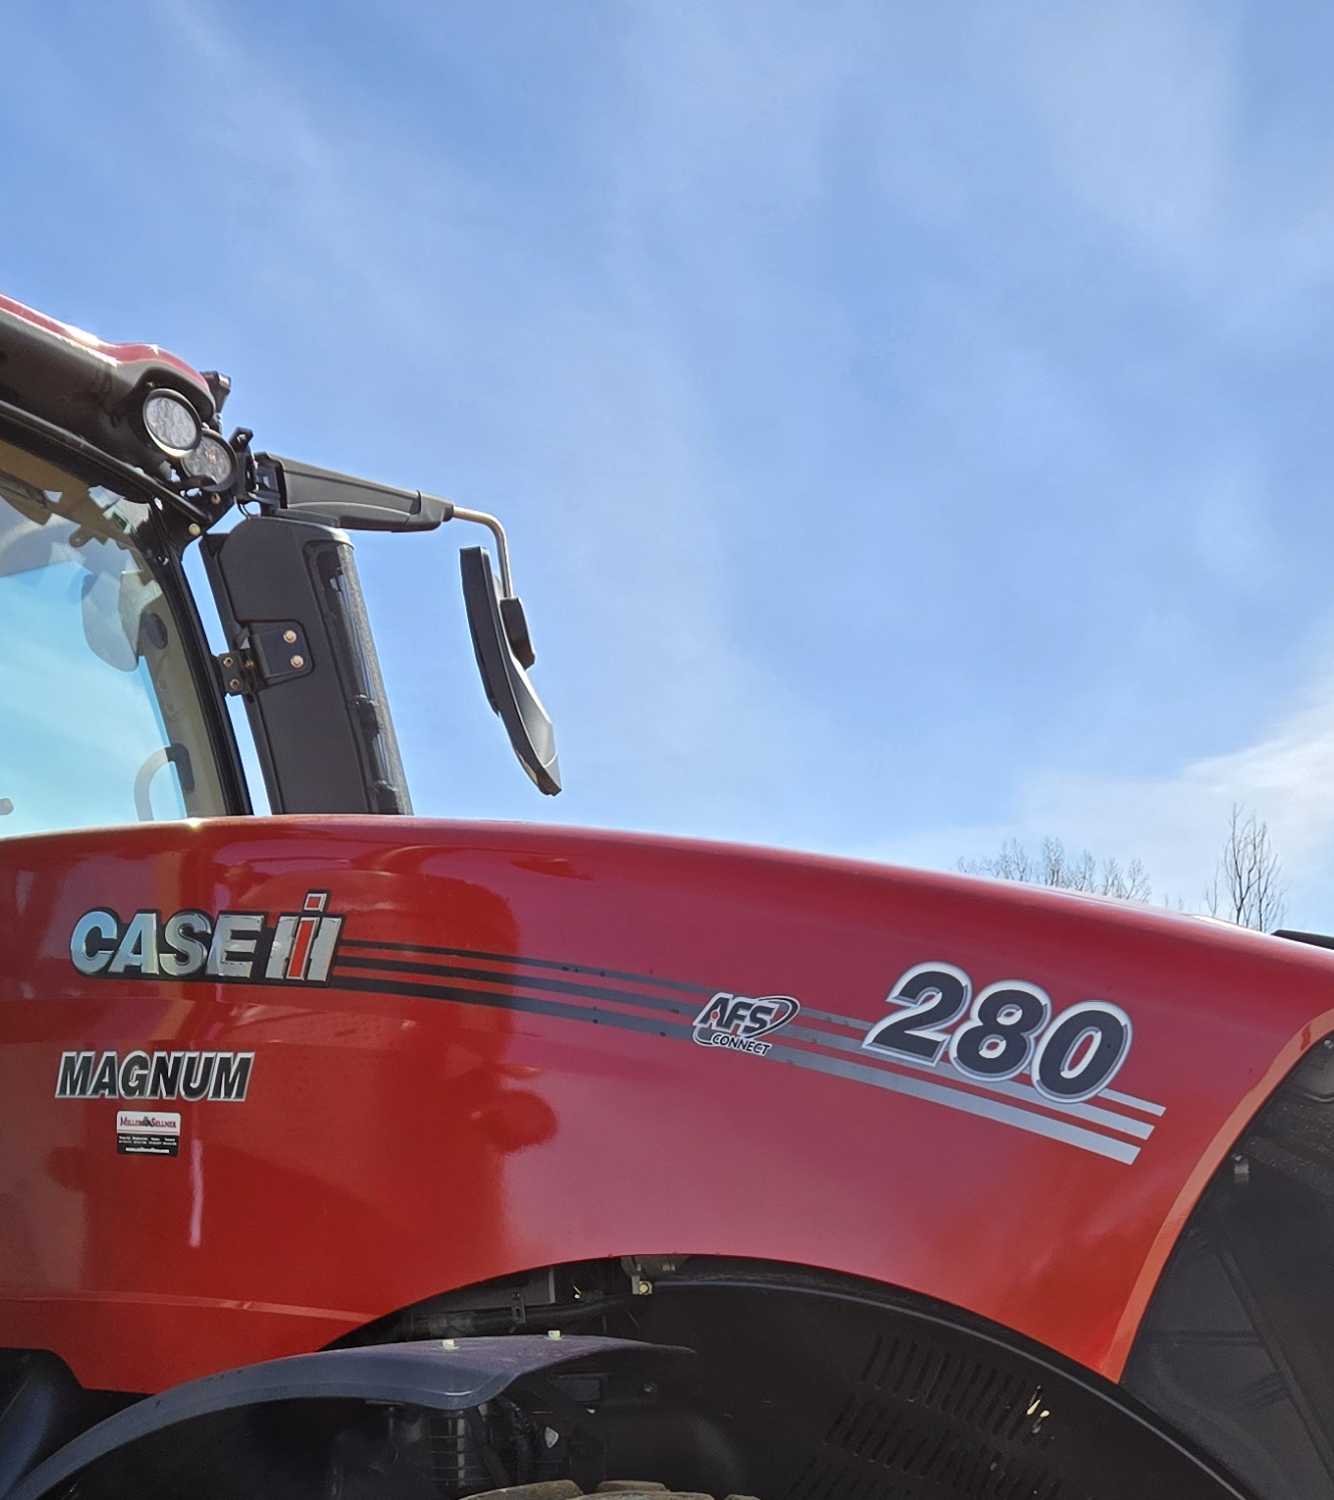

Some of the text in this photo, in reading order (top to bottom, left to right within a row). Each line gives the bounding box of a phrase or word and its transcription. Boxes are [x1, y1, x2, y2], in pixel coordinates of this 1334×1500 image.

[70, 910, 265, 979] CASE
[693, 992, 780, 1036] AFS
[862, 961, 1133, 1103] 280
[711, 1033, 772, 1056] CONNECT
[55, 1050, 255, 1101] MAGNUM
